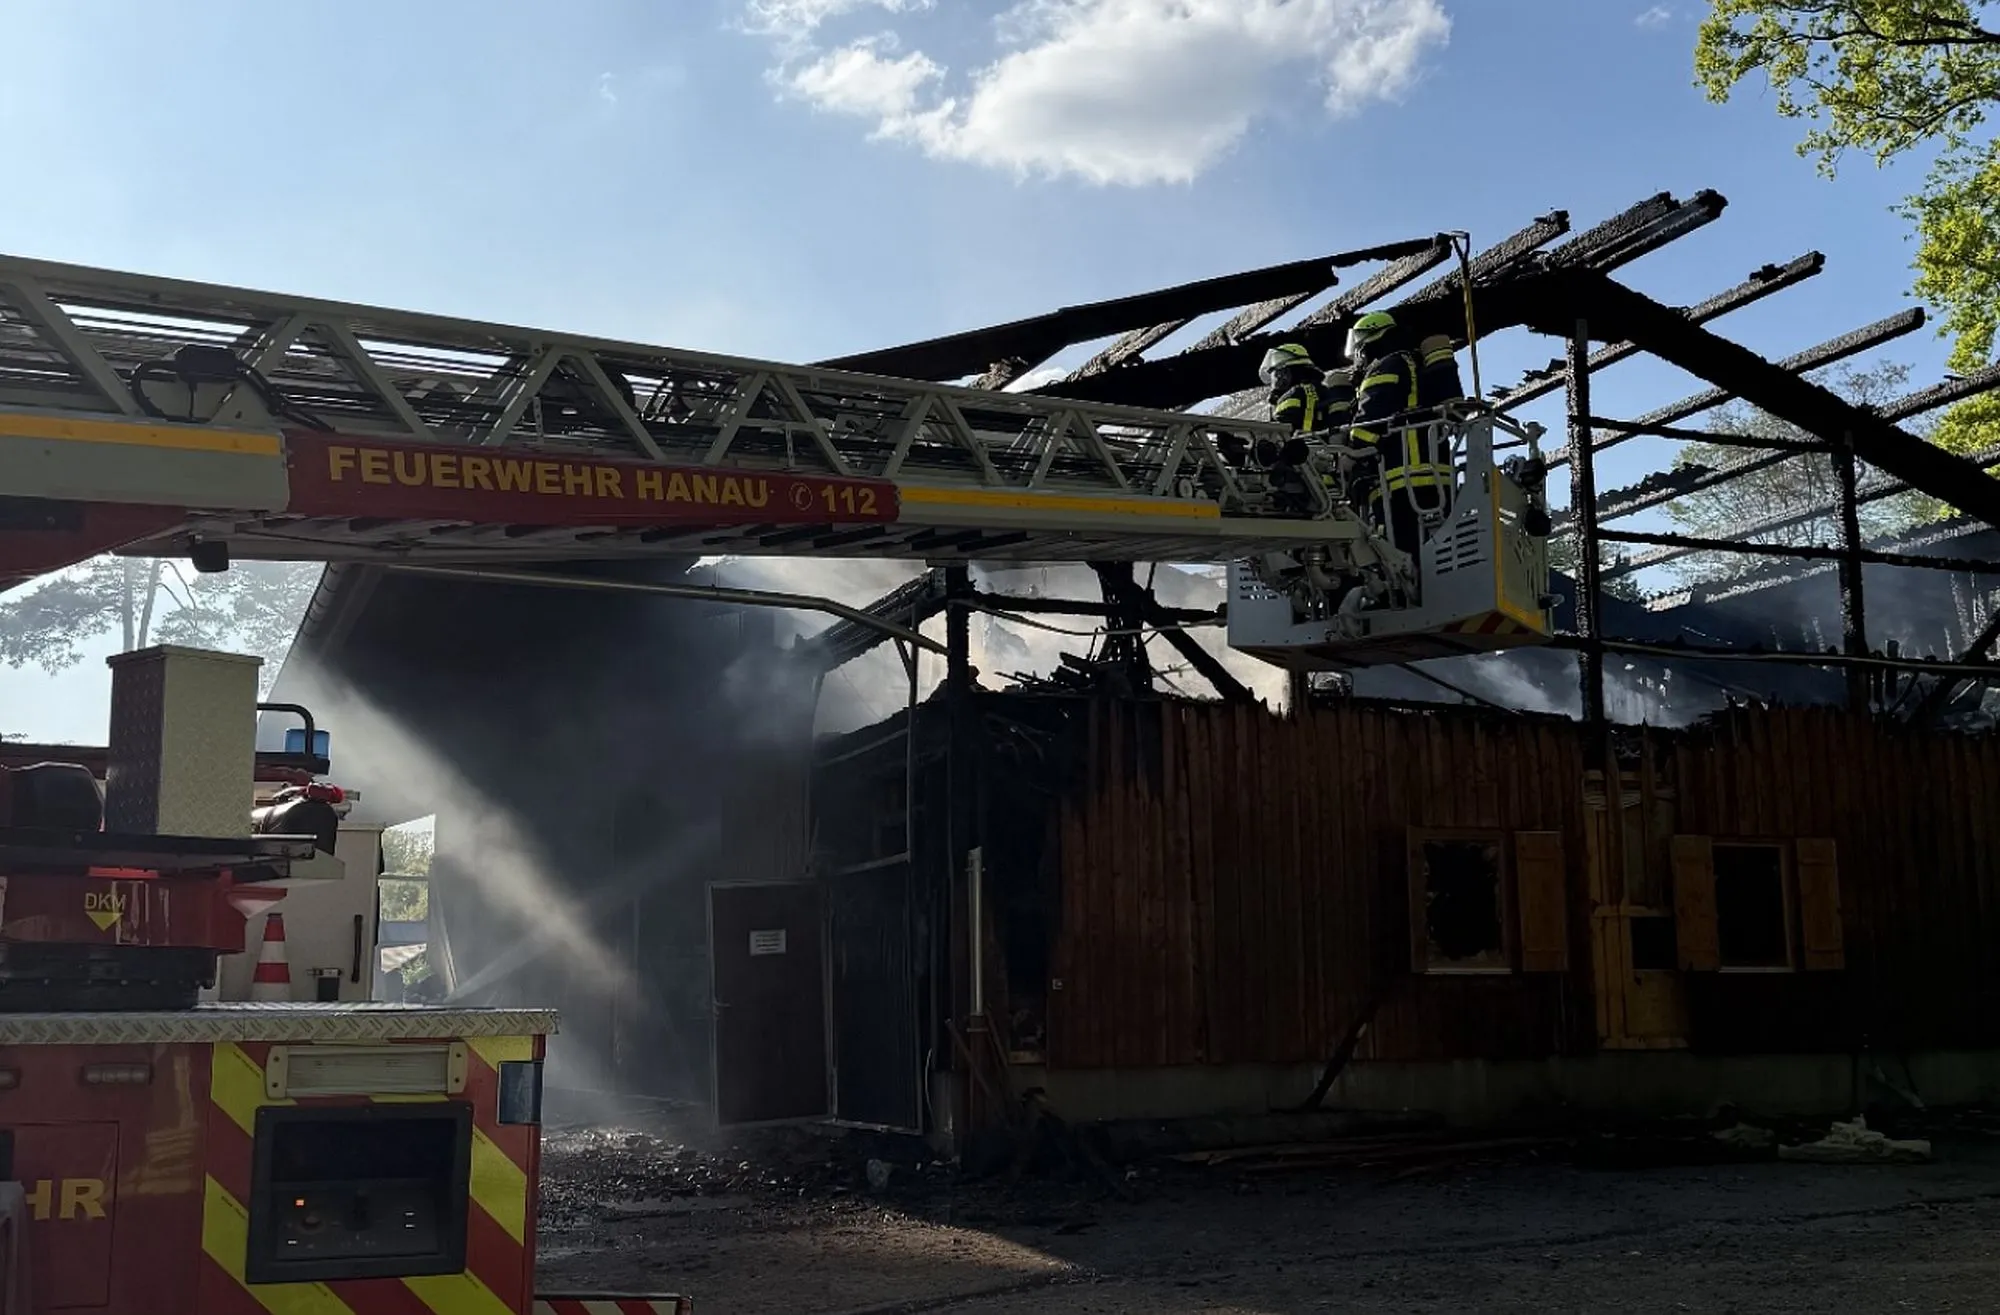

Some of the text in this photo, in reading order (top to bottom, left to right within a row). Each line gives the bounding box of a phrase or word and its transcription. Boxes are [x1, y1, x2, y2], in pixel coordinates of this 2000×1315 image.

[328, 446, 878, 515] FEUERWEHR HANAU 112
[85, 892, 127, 910] DKM
